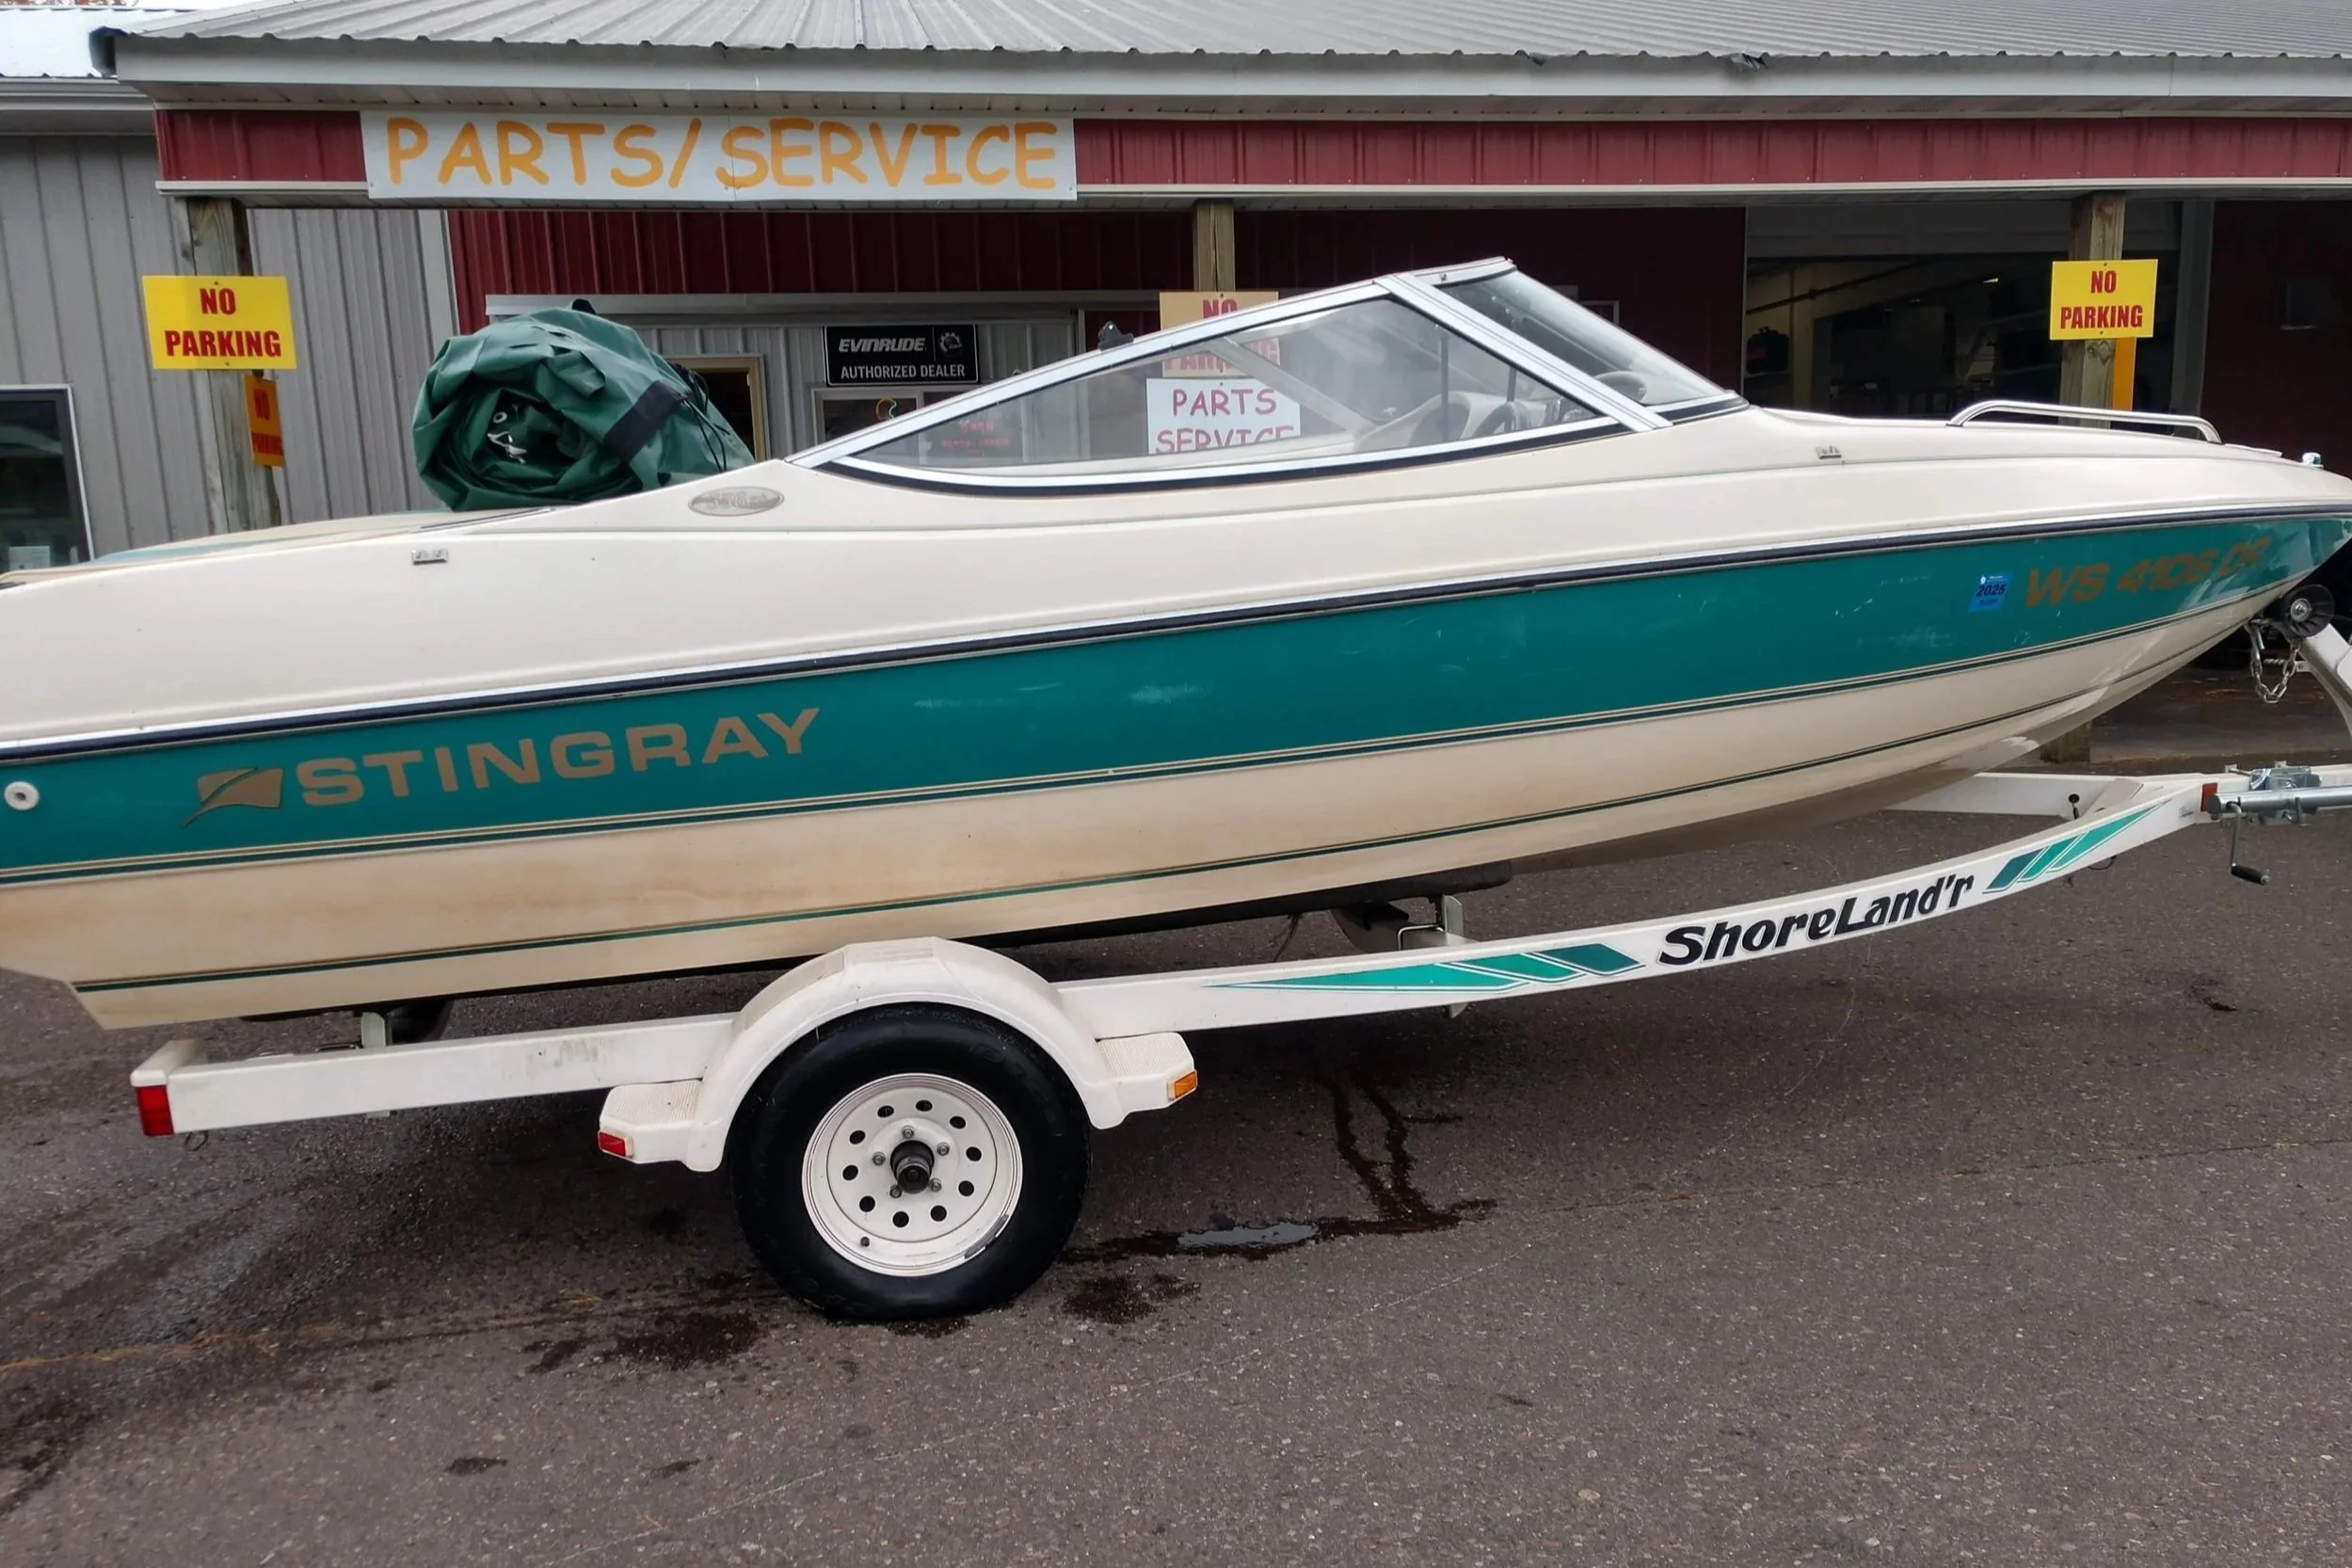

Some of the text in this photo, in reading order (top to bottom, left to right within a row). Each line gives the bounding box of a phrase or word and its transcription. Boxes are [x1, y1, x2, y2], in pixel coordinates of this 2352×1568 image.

[2090, 270, 2118, 294] NO
[200, 288, 236, 314] NO
[2060, 305, 2143, 329] PARKING
[165, 330, 281, 357] PARKING
[839, 337, 926, 352] EVINRUDE
[841, 363, 965, 379] AUTHORIZED DEALER
[1173, 389, 1277, 416] PARTS
[1976, 584, 2008, 598] 2025
[2026, 563, 2110, 607] WS
[296, 708, 821, 807] STINGRAY
[1658, 873, 1975, 966] ShoreLand'r
